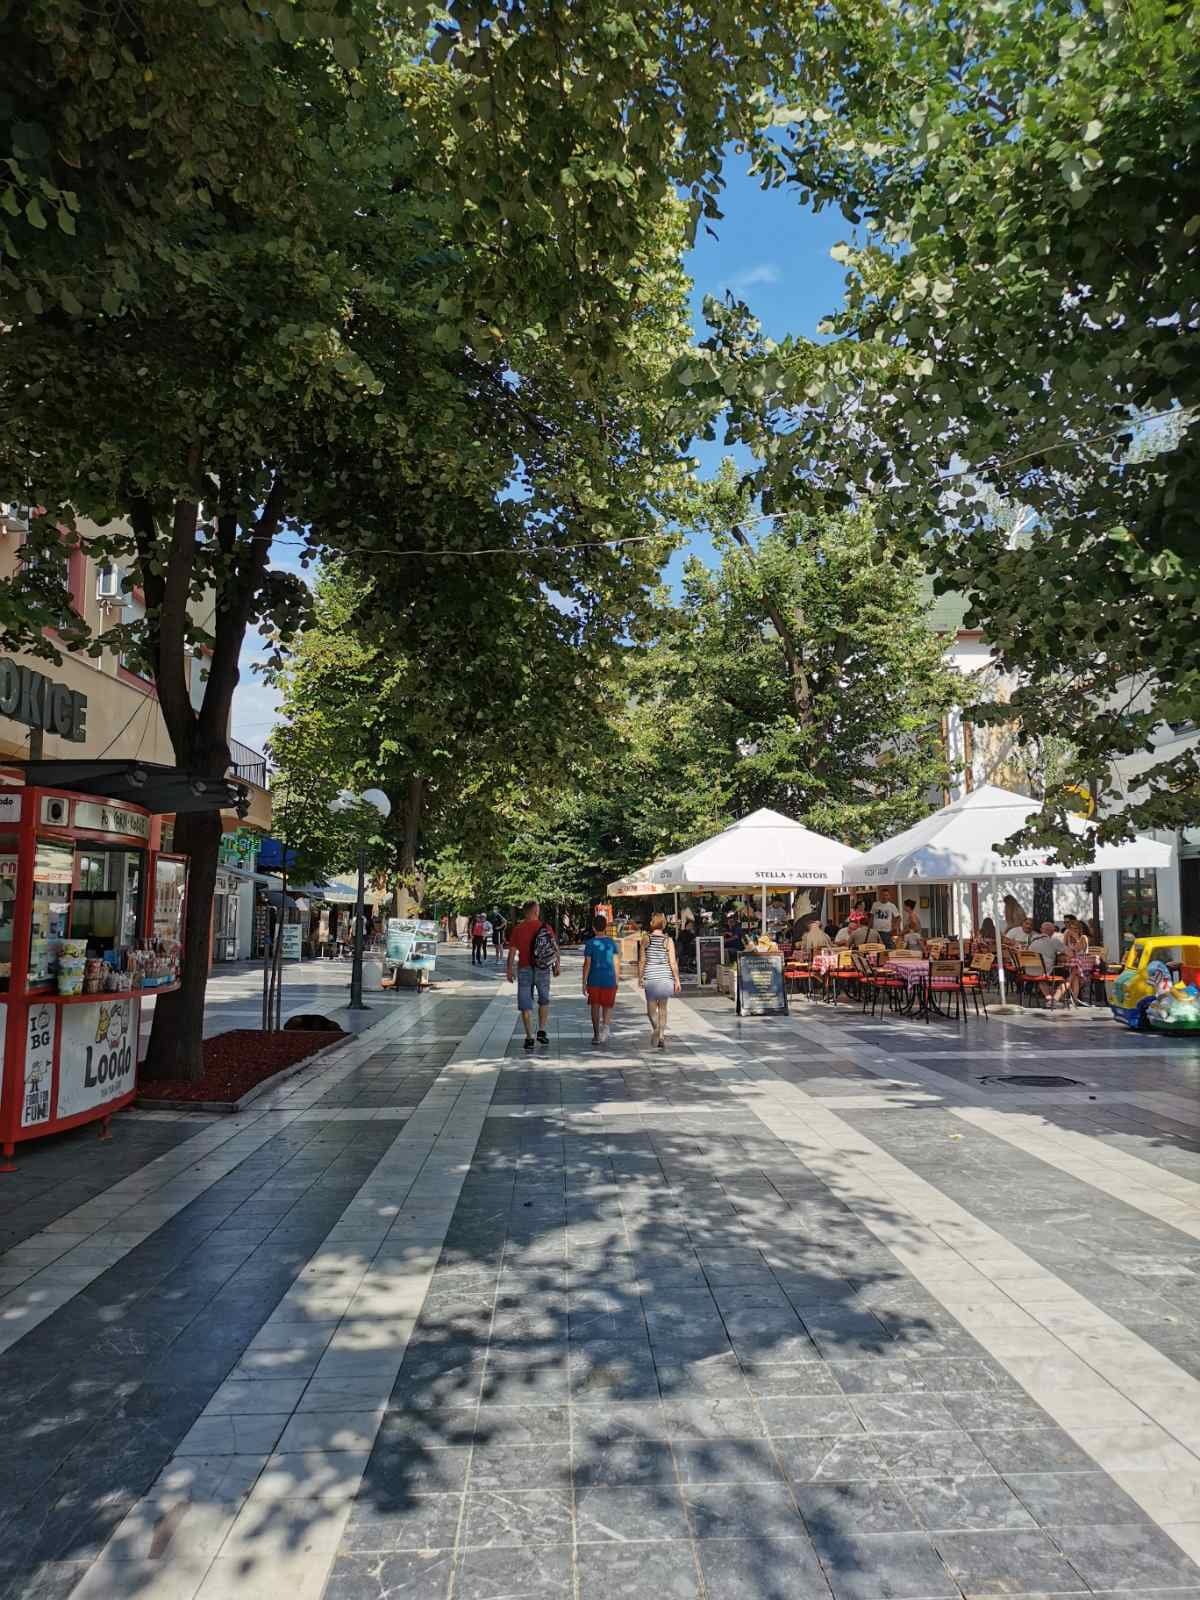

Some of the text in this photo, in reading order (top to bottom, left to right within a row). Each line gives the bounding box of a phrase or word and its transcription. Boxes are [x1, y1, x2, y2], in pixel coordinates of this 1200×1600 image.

[1000, 859, 1039, 868] STELLA
[755, 872, 829, 881] STELLA ARTOIS
[31, 1032, 51, 1050] BG
[84, 1036, 132, 1088] Loodo
